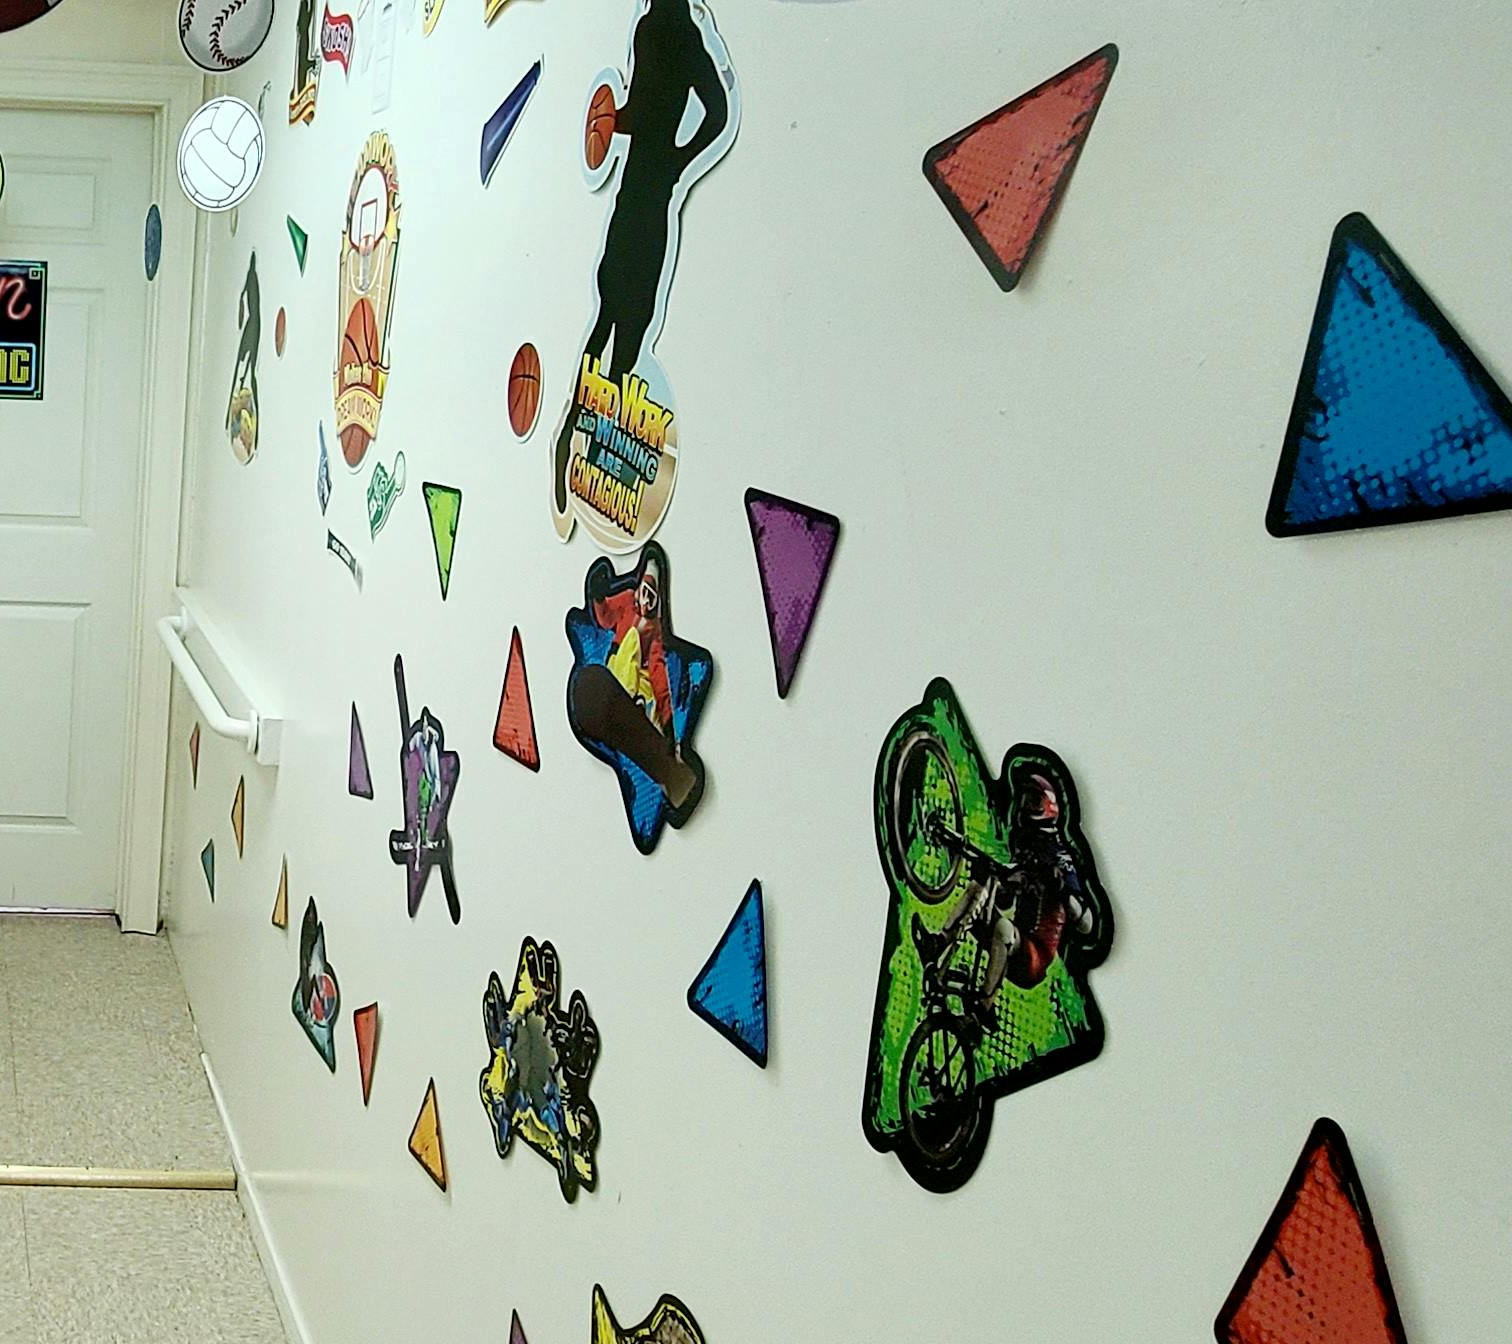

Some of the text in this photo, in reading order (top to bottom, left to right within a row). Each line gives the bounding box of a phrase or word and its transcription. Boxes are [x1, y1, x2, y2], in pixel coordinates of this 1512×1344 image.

[575, 413, 596, 434] AND
[577, 352, 674, 453] HARD WORK
[595, 449, 623, 478] ARE
[570, 454, 646, 535] CONTAGIOUS!
